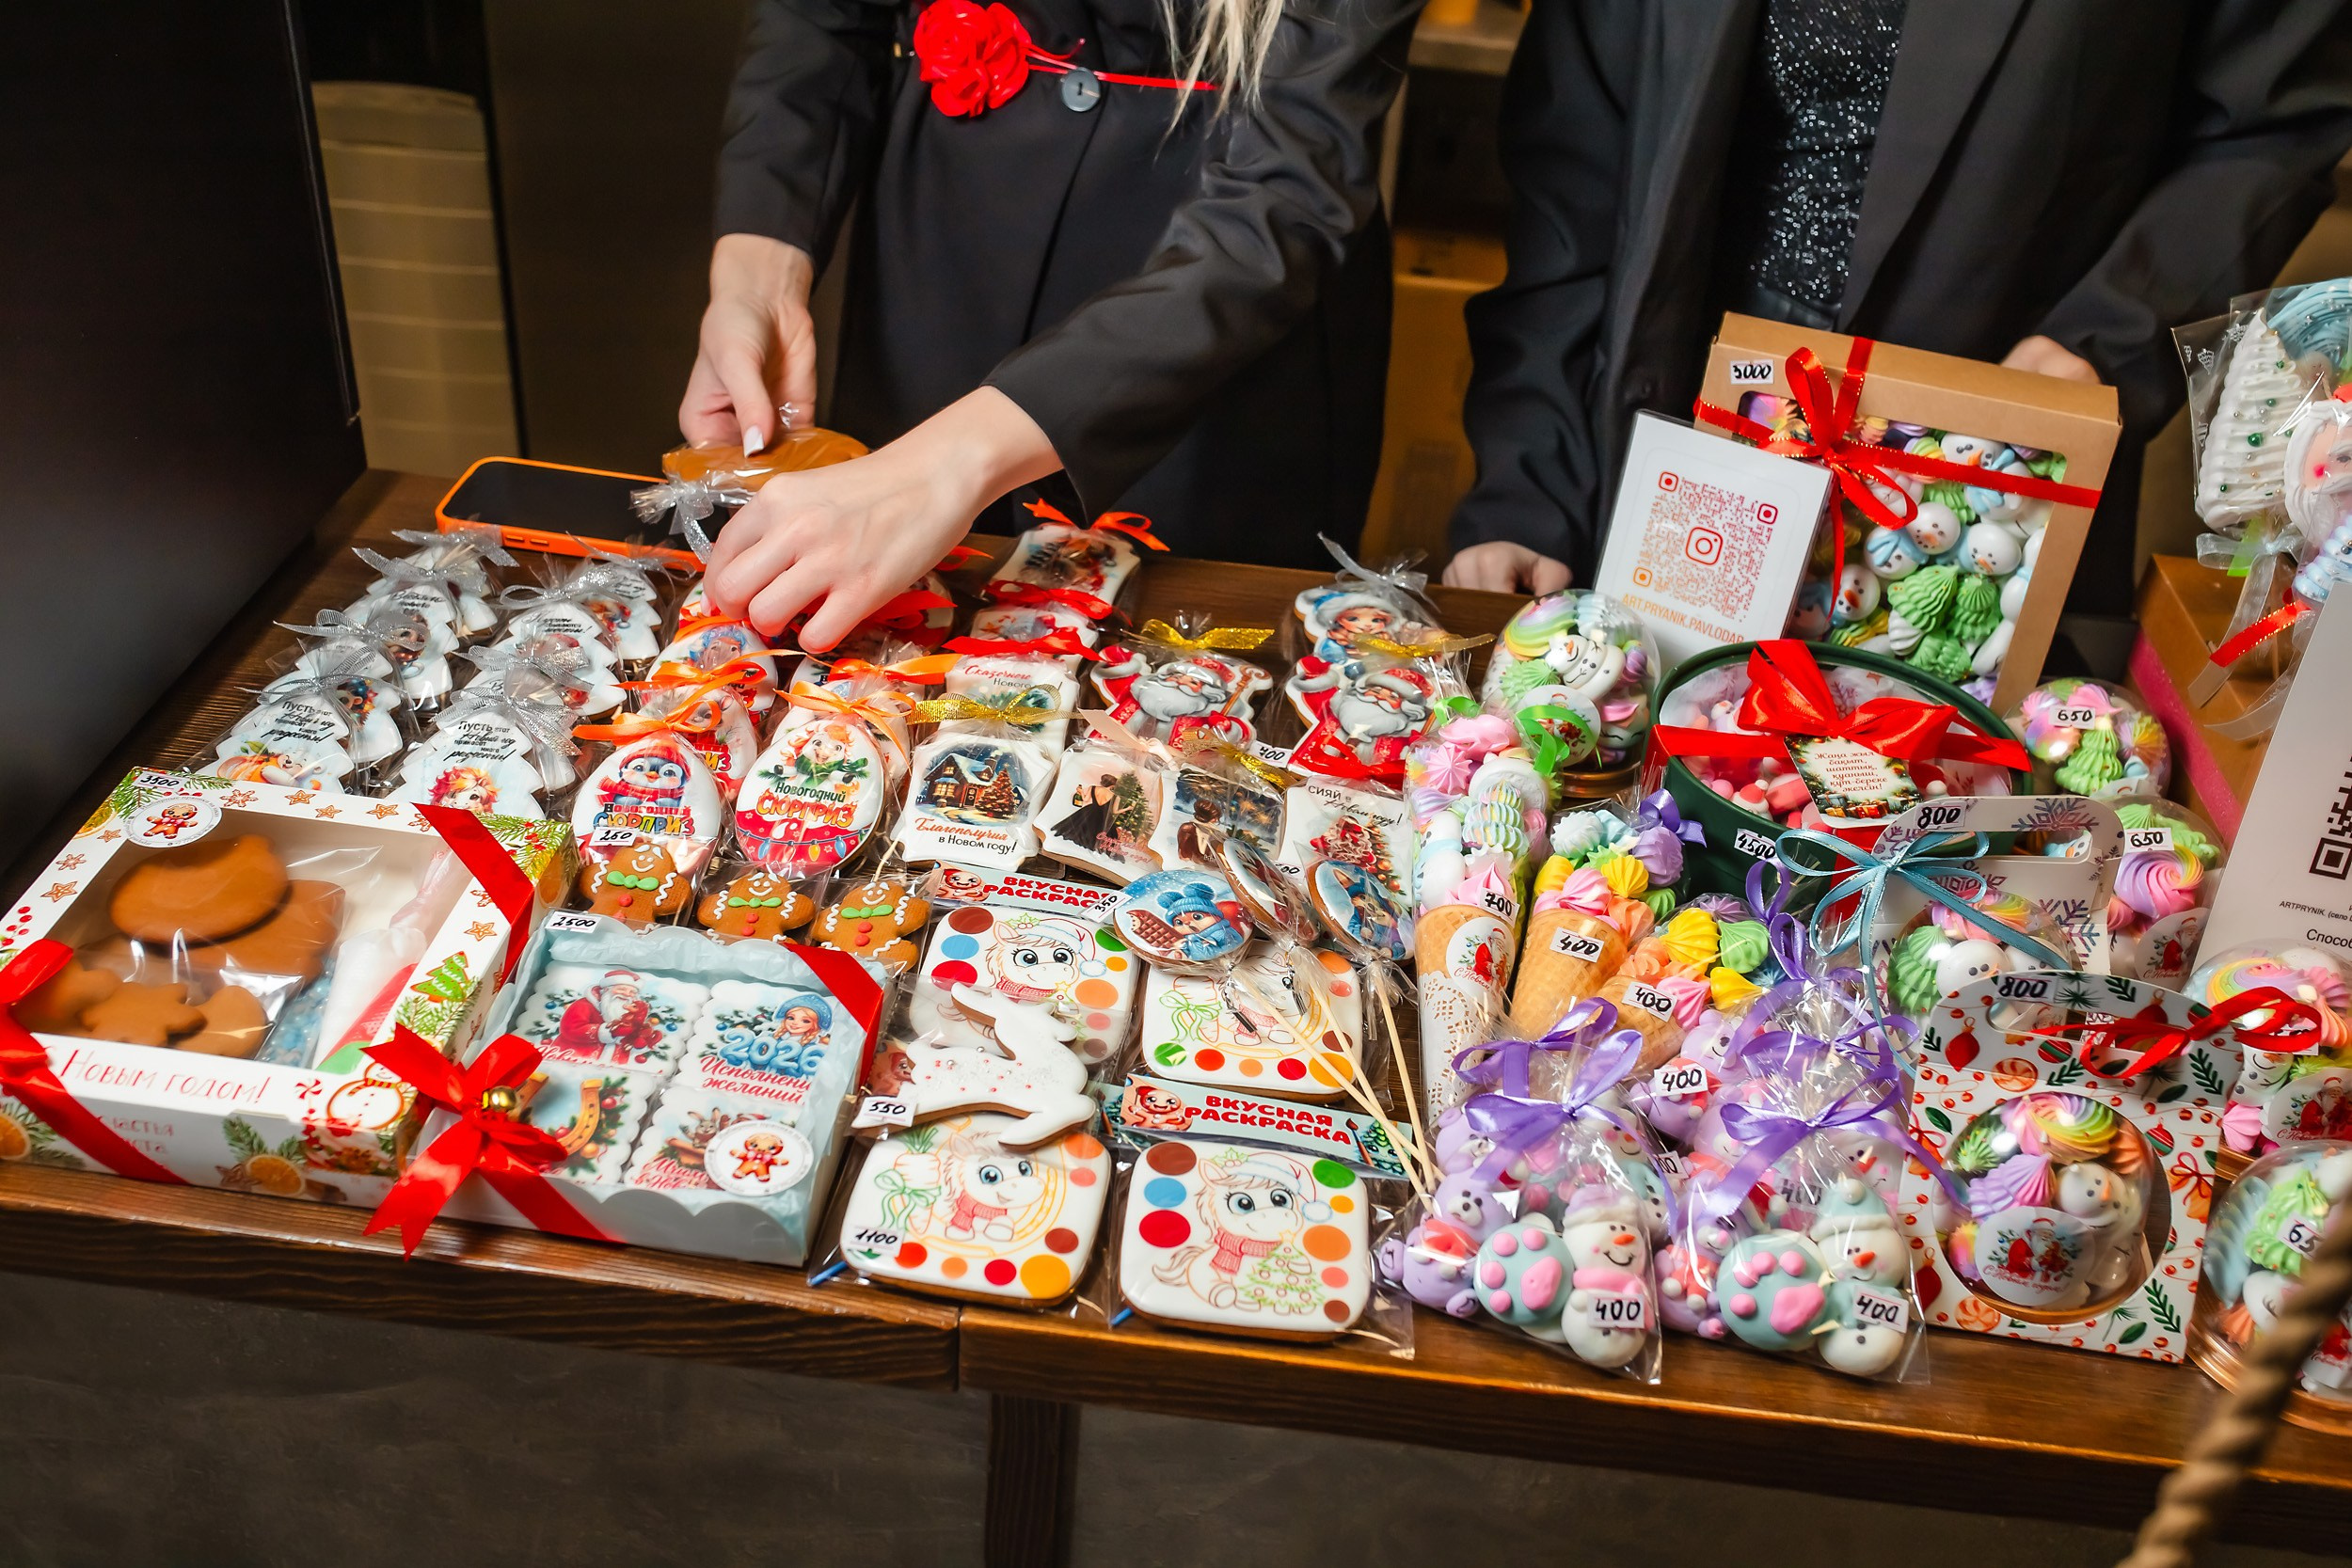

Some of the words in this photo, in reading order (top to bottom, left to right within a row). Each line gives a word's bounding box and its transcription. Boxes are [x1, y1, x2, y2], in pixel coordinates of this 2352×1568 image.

[1622, 594, 1744, 643] ART.PRYANIK.PAVLODAR
[963, 664, 1032, 679] Сказочного
[993, 677, 1032, 689] Нового
[281, 701, 315, 714] Пусть
[2057, 708, 2094, 723] 650
[458, 721, 493, 732] Пусть
[140, 775, 180, 787] 3500
[774, 782, 847, 802] Новогодний
[1308, 785, 1342, 800] СИЯЙ
[603, 803, 691, 816] Новогодний
[756, 790, 858, 828] СЮРПРИЗ
[1917, 806, 1962, 828] 800
[593, 812, 696, 836] СЮРПРИЗ
[914, 817, 1009, 841] Благополучия
[599, 830, 633, 841] 250
[947, 834, 985, 848] Новом
[986, 839, 1018, 855] году!
[2130, 831, 2165, 848] 650
[982, 884, 1097, 908] РАСКРАС
[1094, 895, 1118, 912] 350
[1485, 893, 1514, 916] 700
[552, 915, 596, 927] 2500
[2328, 911, 2348, 921] (село
[1559, 934, 1599, 956] 400
[1999, 979, 2047, 999] 800
[1635, 988, 1673, 1012] 400
[718, 1027, 829, 1078] 2026
[60, 1049, 158, 1090] Новым
[163, 1075, 272, 1104] годом!
[700, 1055, 811, 1090] Исполнени
[1661, 1069, 1704, 1091] 400
[868, 1101, 909, 1115] 550
[1204, 1094, 1334, 1128] ВКУСНАЯ
[1184, 1105, 1353, 1147] РАСКРАСКА
[1655, 1157, 1678, 1174] 00
[855, 1227, 898, 1244] 1100
[2289, 1224, 2326, 1252] 65
[1595, 1298, 1641, 1324] 400
[1855, 1294, 1899, 1322] 400
